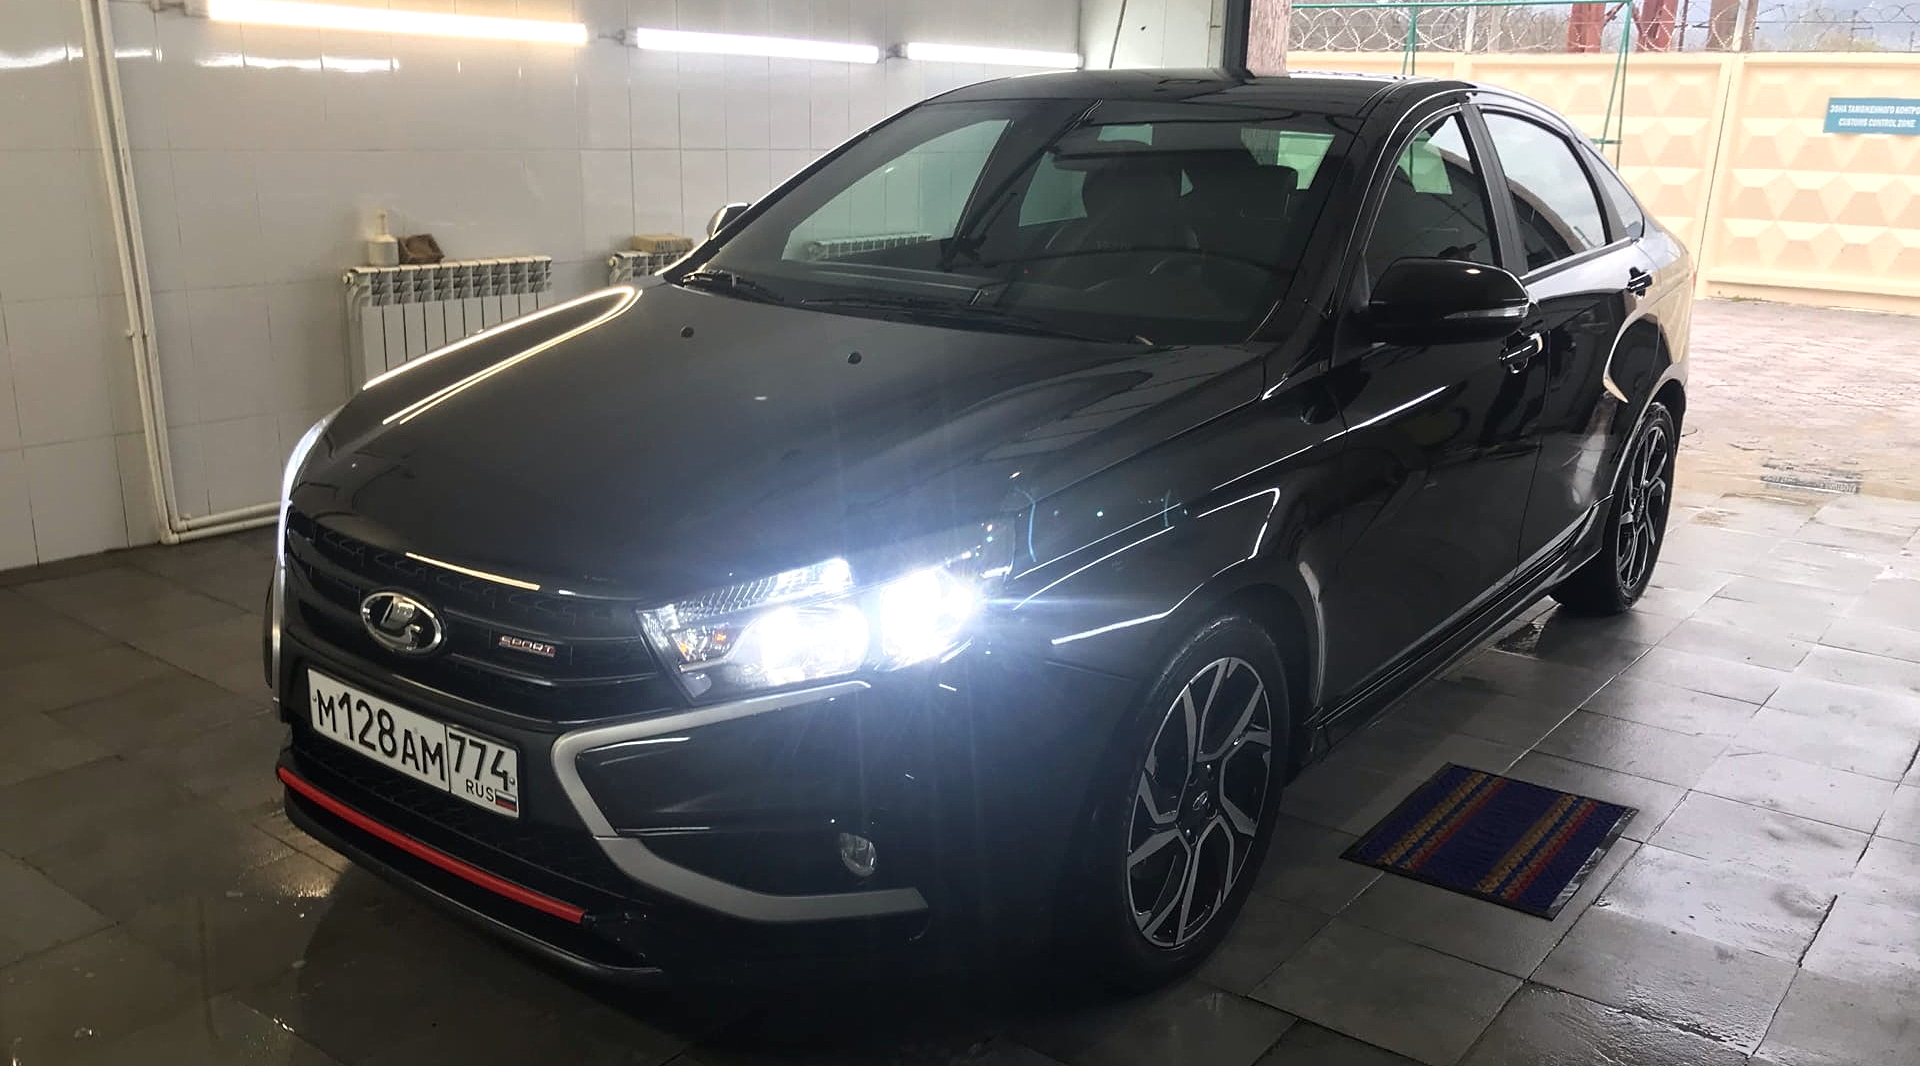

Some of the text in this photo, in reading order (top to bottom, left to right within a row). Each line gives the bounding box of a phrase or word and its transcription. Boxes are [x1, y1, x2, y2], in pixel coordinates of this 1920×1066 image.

[1830, 104, 1847, 113] ЗОНА
[1838, 117, 1917, 128] CUSTOMS CONTROL ZONE
[499, 635, 555, 655] SPORT
[448, 732, 509, 791] 774
[465, 778, 495, 802] RUS
